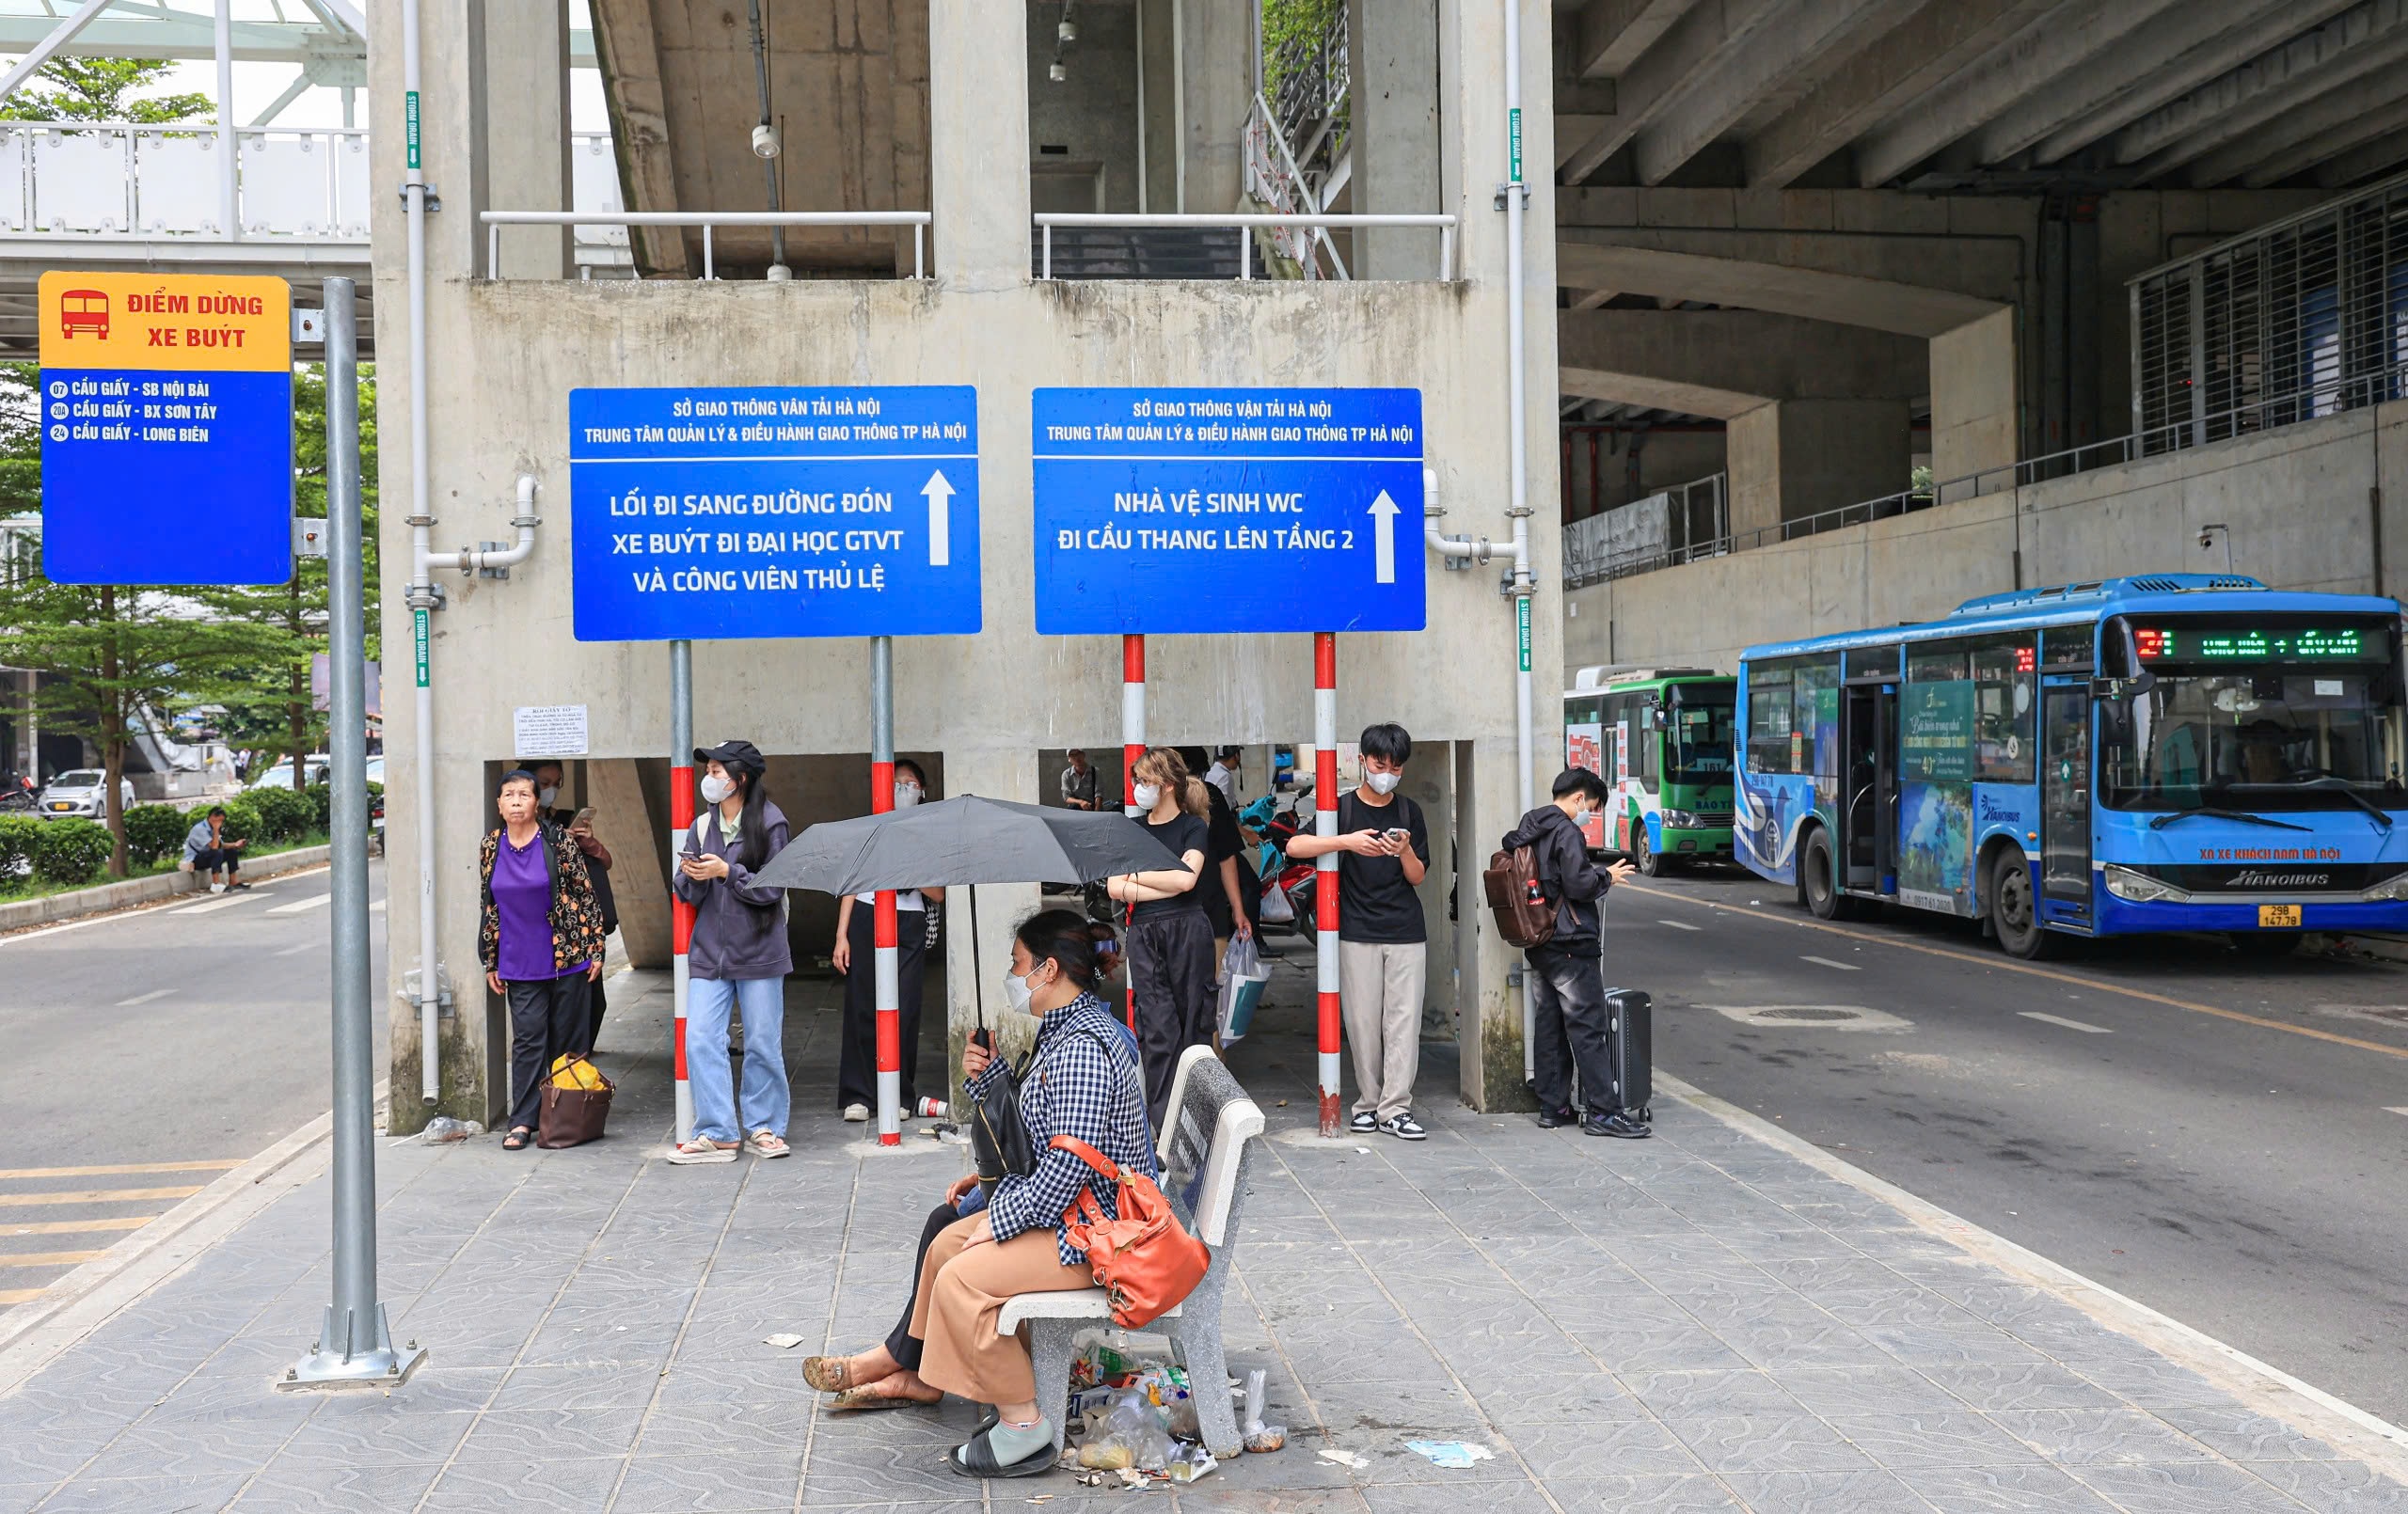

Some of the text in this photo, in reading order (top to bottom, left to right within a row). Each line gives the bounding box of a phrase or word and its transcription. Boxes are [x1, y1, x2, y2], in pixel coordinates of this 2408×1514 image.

[407, 95, 418, 145] STORM DRAIN
[1512, 113, 1521, 159] STORM DRAIN
[127, 286, 262, 316] ĐIỂM DỪNG
[148, 323, 246, 348] XE BUÝT
[54, 386, 64, 394] 07
[71, 376, 98, 396] CẦU
[101, 377, 130, 396] GIẤY
[142, 382, 160, 397] SB
[162, 380, 185, 400] NỘI
[187, 380, 210, 397] BÀI
[54, 406, 66, 416] 20A
[72, 400, 99, 418] CẦU
[103, 400, 133, 418] GIẤY
[144, 404, 162, 418] BX
[165, 403, 191, 419] SƠN
[194, 402, 217, 419] TÂY
[673, 396, 880, 418] SỞ GIAO THÔNG VÂN TẢI HÀ NỘI
[1133, 398, 1332, 420] SỞ GIAO THÔNG VẬN TẢI HÀ NỘI
[54, 428, 65, 438] 24
[72, 420, 99, 440] CẦU
[102, 422, 132, 440] GIẤY
[143, 427, 177, 442] LONG
[179, 425, 209, 442] BIÊN
[584, 420, 967, 443] TRUNG TÂM QUẢN LÝ & ĐIỀU HÀNH GIAO THÔNG TP HÀ NỘI
[1046, 421, 1413, 445] TRUNG TÂM QUẢN LÝ & ĐIỀU HÀNH GIAO THÔNG TP HÀ NỘI
[610, 486, 892, 516] LỐI ĐI SANG ĐƯỜNG ĐÓN
[1115, 486, 1303, 516] NHÀ VỆ SINH WC
[612, 527, 904, 556] XE BUÝT ĐI ĐẠI HỌC GTVT
[1057, 520, 1354, 550] ĐI CẦU THANG LÊN TẦNG 2
[632, 560, 885, 592] VÀ CÔNG VIÊN THỦ LỆ
[1521, 603, 1529, 649] STORM DRAIN
[417, 614, 427, 663] STORM DRAIN
[2218, 848, 2231, 860] XE
[2226, 870, 2329, 886] HANOIBUS
[2264, 916, 2297, 926] 147.78
[2271, 906, 2289, 916] 29B
